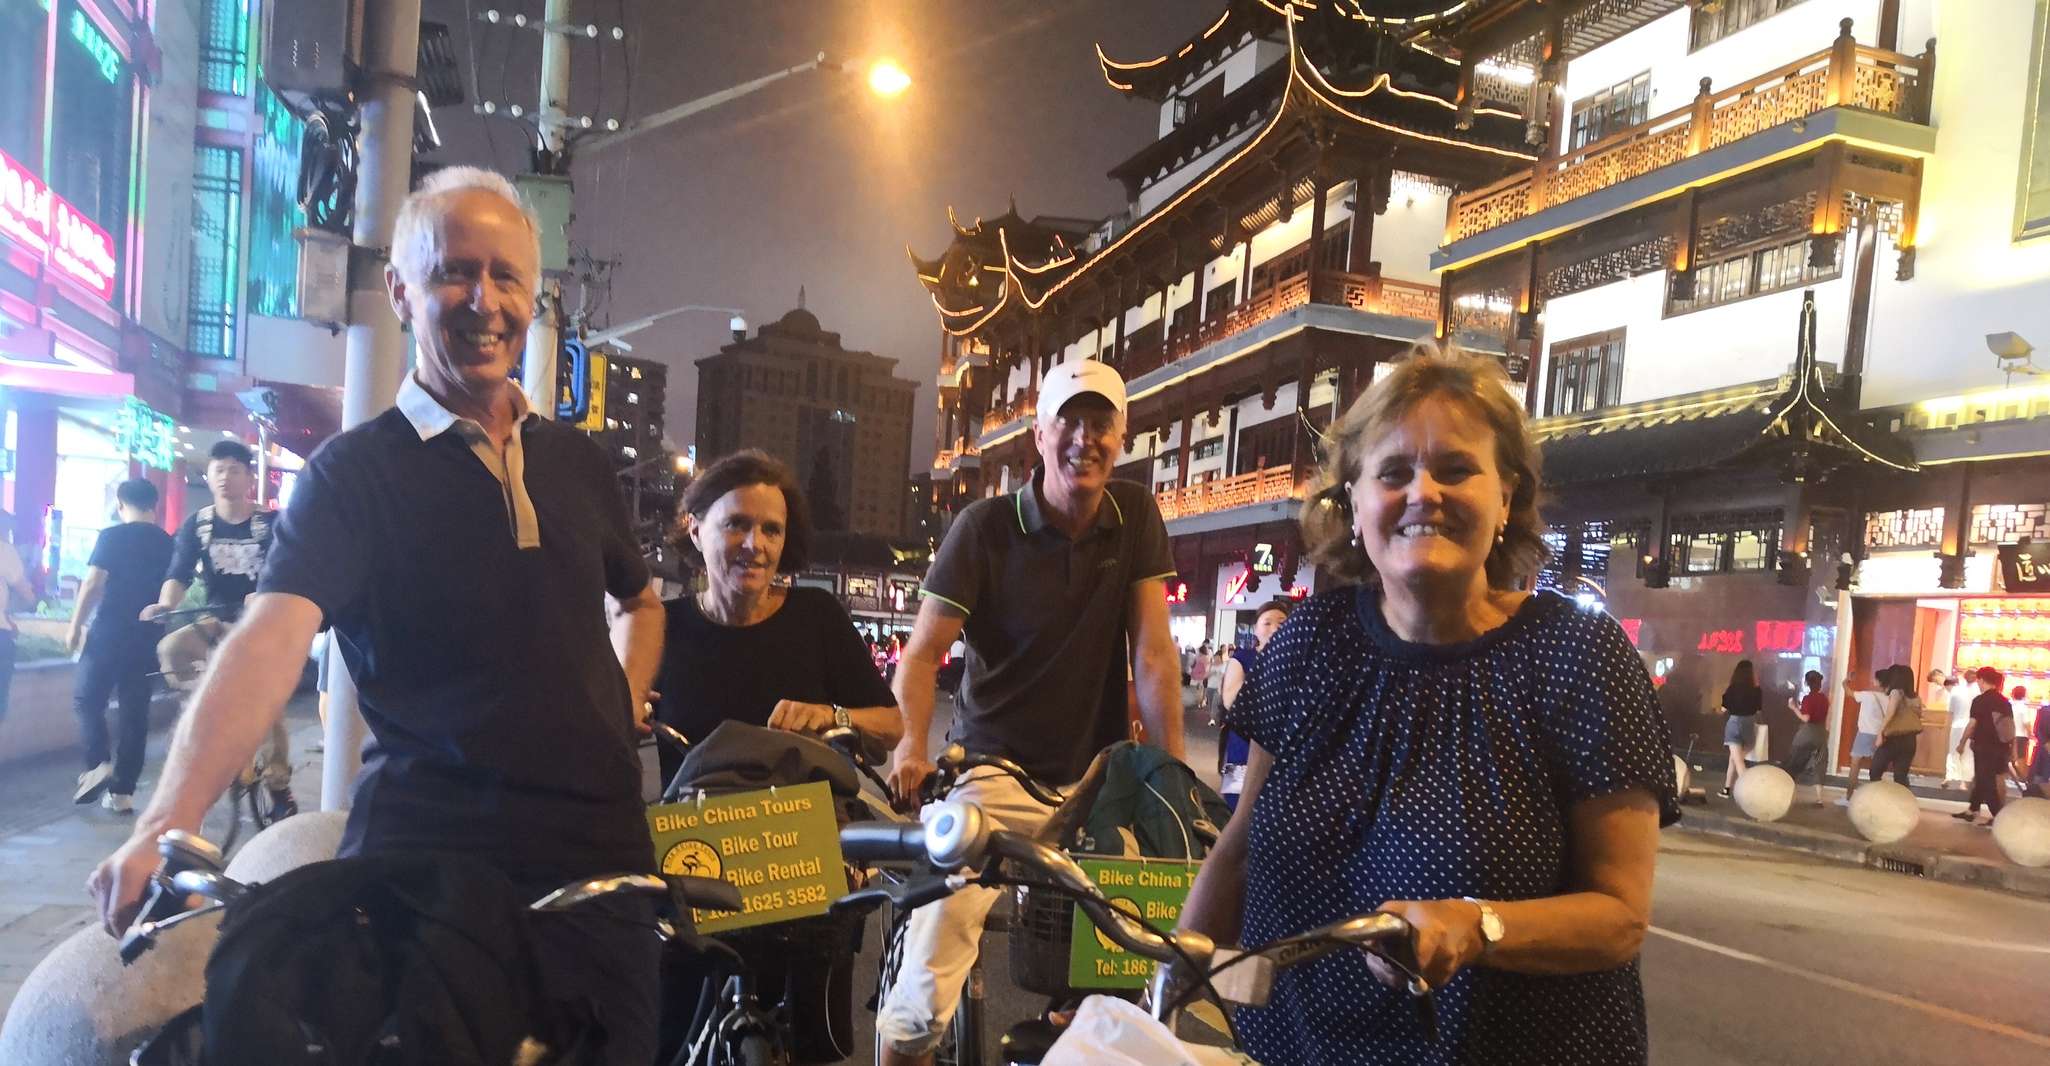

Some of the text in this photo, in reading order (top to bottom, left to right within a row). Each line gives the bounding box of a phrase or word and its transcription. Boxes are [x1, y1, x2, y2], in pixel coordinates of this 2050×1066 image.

[656, 798, 812, 832] Bike China Tours
[720, 835, 760, 856] Bike
[762, 831, 798, 850] Tour
[726, 857, 822, 887] Bike Rental
[1099, 870, 1134, 886] Bike
[1138, 871, 1182, 887] China
[742, 890, 784, 914] 1625
[787, 885, 828, 906] 3582
[1146, 901, 1177, 919] Bike
[1095, 958, 1118, 976] Tel:
[1122, 959, 1148, 976] 186
